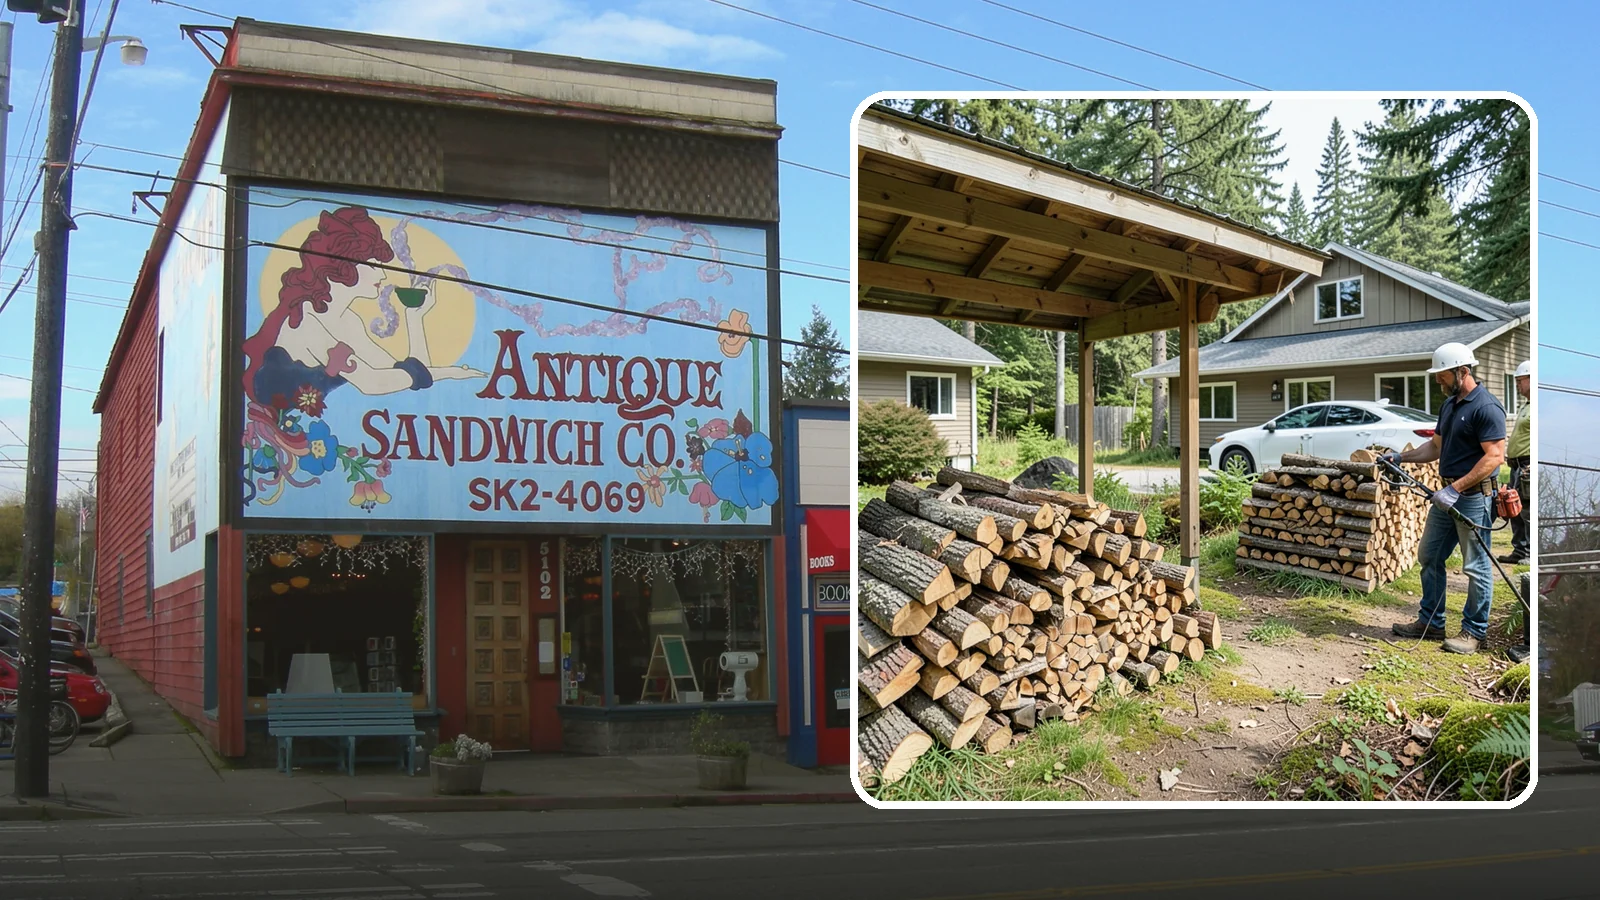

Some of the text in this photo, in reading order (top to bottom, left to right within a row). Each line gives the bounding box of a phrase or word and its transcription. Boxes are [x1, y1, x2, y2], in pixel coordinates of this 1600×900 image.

[476, 329, 724, 421] ANTIQUE
[361, 409, 685, 469] SANDWICH CO.
[468, 477, 645, 513] SK2-4069
[539, 541, 552, 600] 5102
[809, 555, 835, 569] BOOKS
